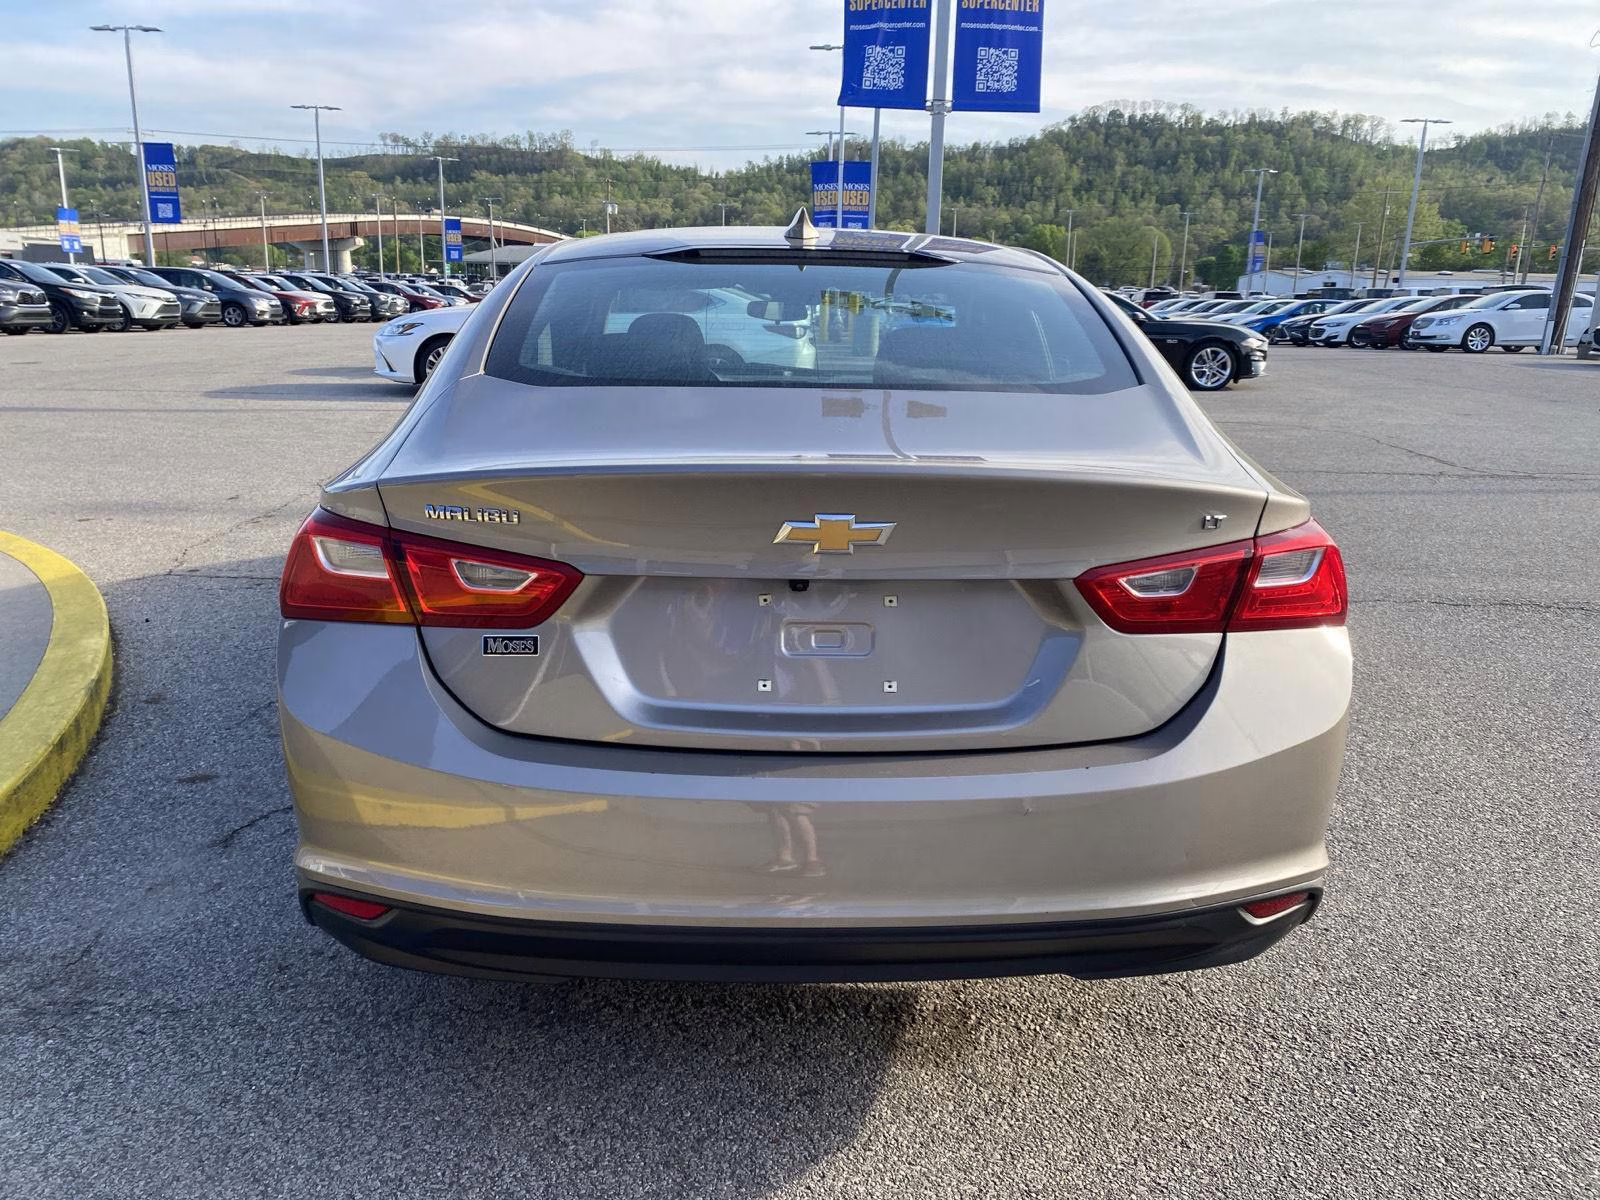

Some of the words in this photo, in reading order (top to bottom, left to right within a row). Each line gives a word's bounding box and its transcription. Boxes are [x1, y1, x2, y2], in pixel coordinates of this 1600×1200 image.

[850, 0, 927, 11] SUPERCENTER
[961, 0, 1039, 12] SUPERCENTER
[850, 21, 926, 31] mosesusedsupercenter.com
[960, 21, 1038, 32] mosesusedsupercenter.com
[148, 171, 176, 187] USED
[844, 183, 870, 191] MOSES
[814, 191, 838, 205] USED
[842, 191, 870, 205] USED
[425, 504, 520, 525] MALIBU
[1202, 515, 1227, 529] LT
[487, 638, 534, 653] MOSES
